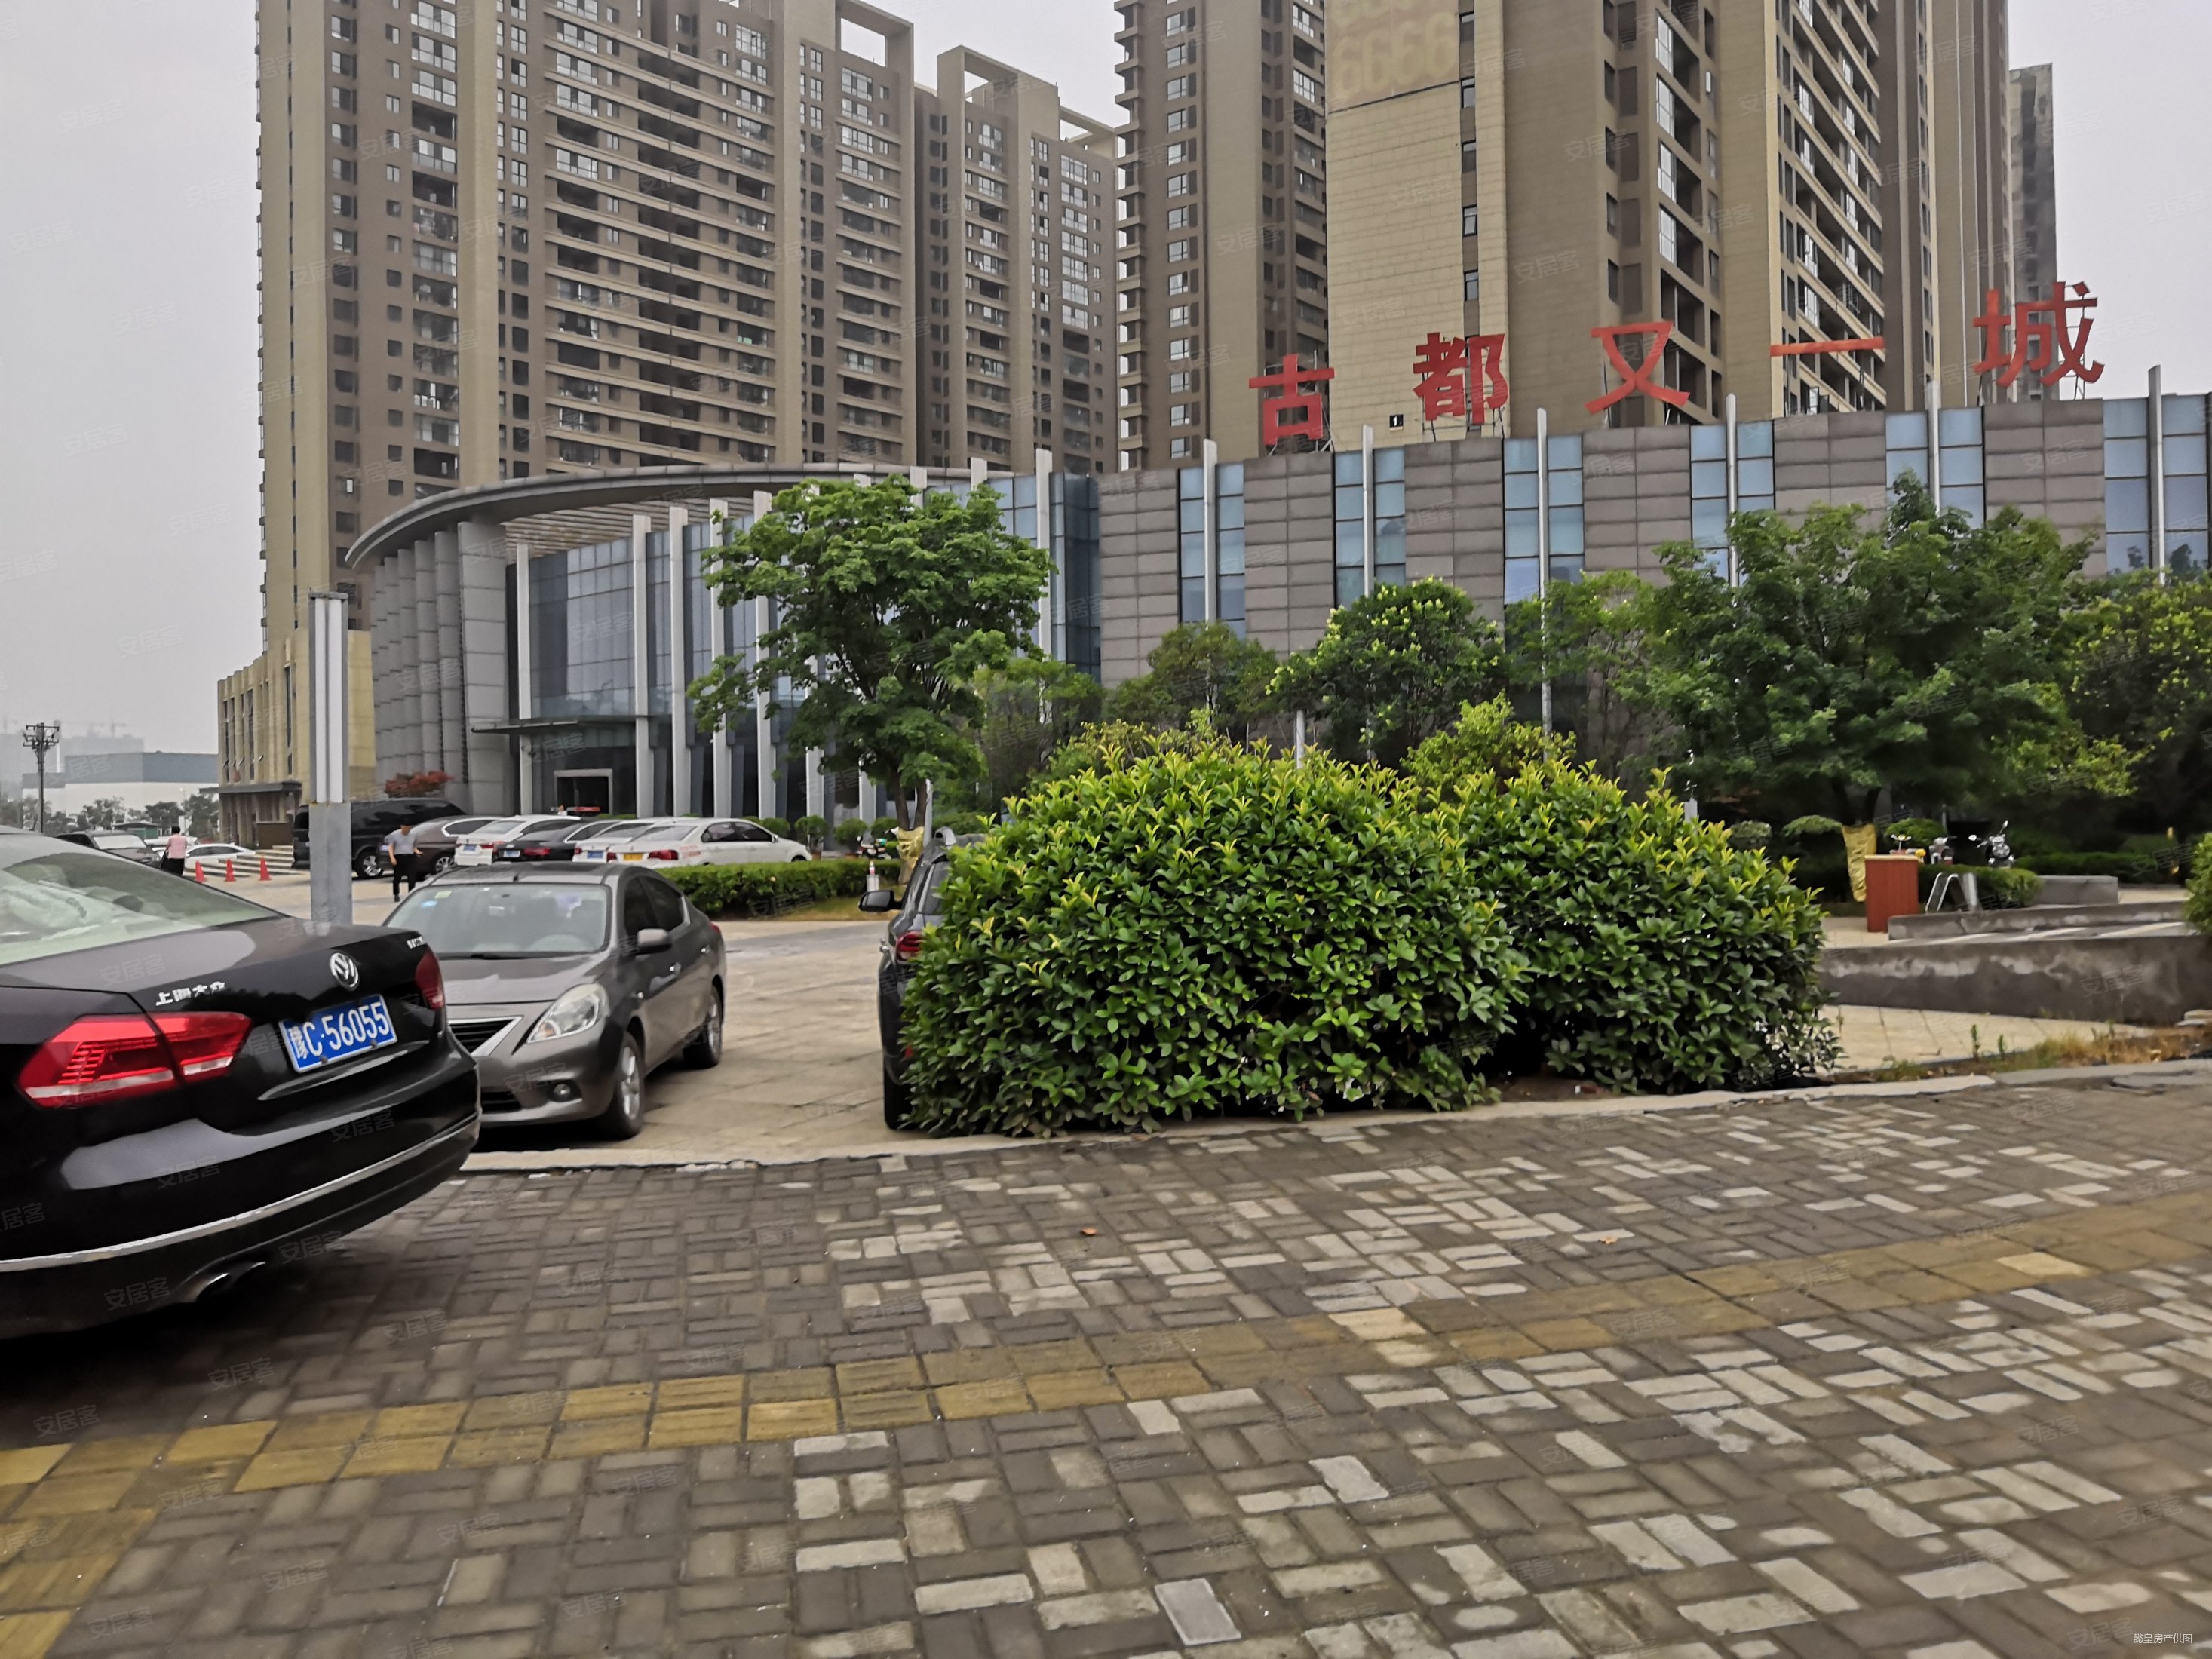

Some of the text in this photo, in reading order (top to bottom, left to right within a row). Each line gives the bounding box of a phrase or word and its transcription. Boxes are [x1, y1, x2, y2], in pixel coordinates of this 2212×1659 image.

[1249, 281, 2104, 446] 古都又一城
